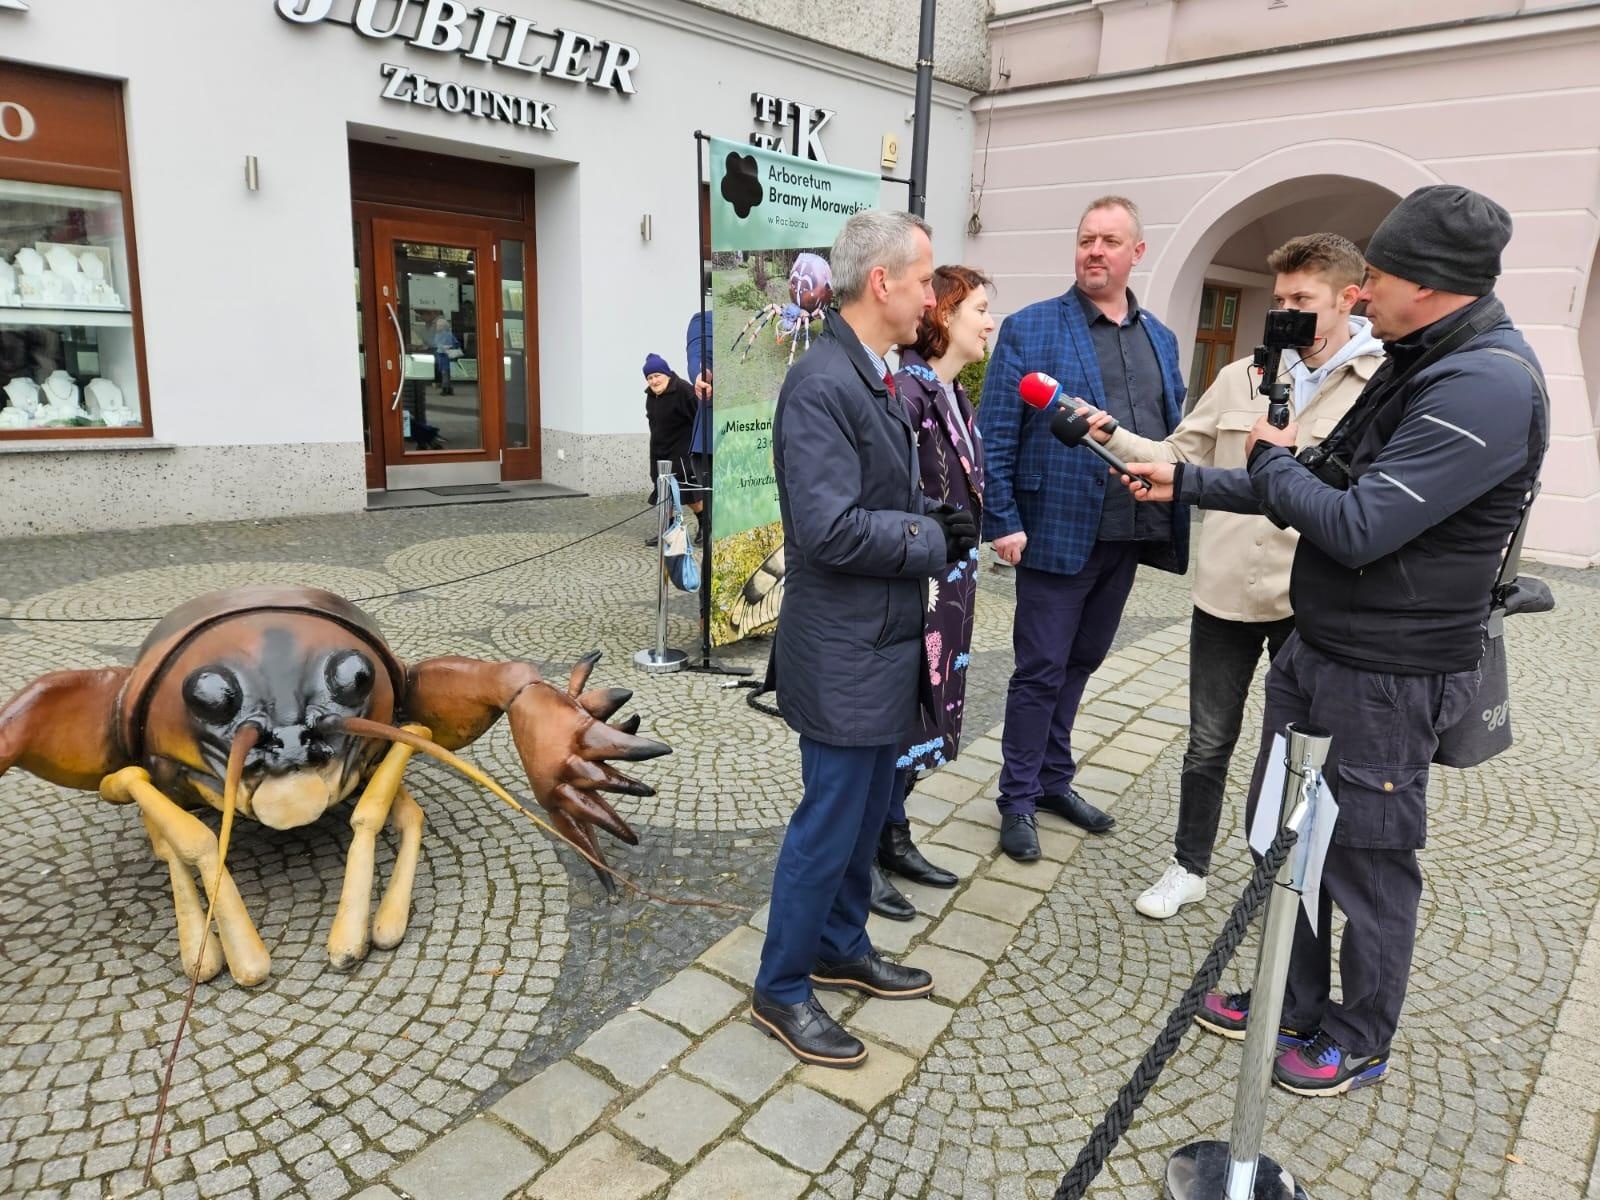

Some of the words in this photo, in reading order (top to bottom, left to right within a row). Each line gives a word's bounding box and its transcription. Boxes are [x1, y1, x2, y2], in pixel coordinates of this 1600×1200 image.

[381, 63, 557, 132] ZŁOTNIK
[768, 165, 831, 191] Arboretum
[769, 187, 808, 212] Bramy
[811, 195, 872, 215] Morawski
[757, 438, 768, 449] 23
